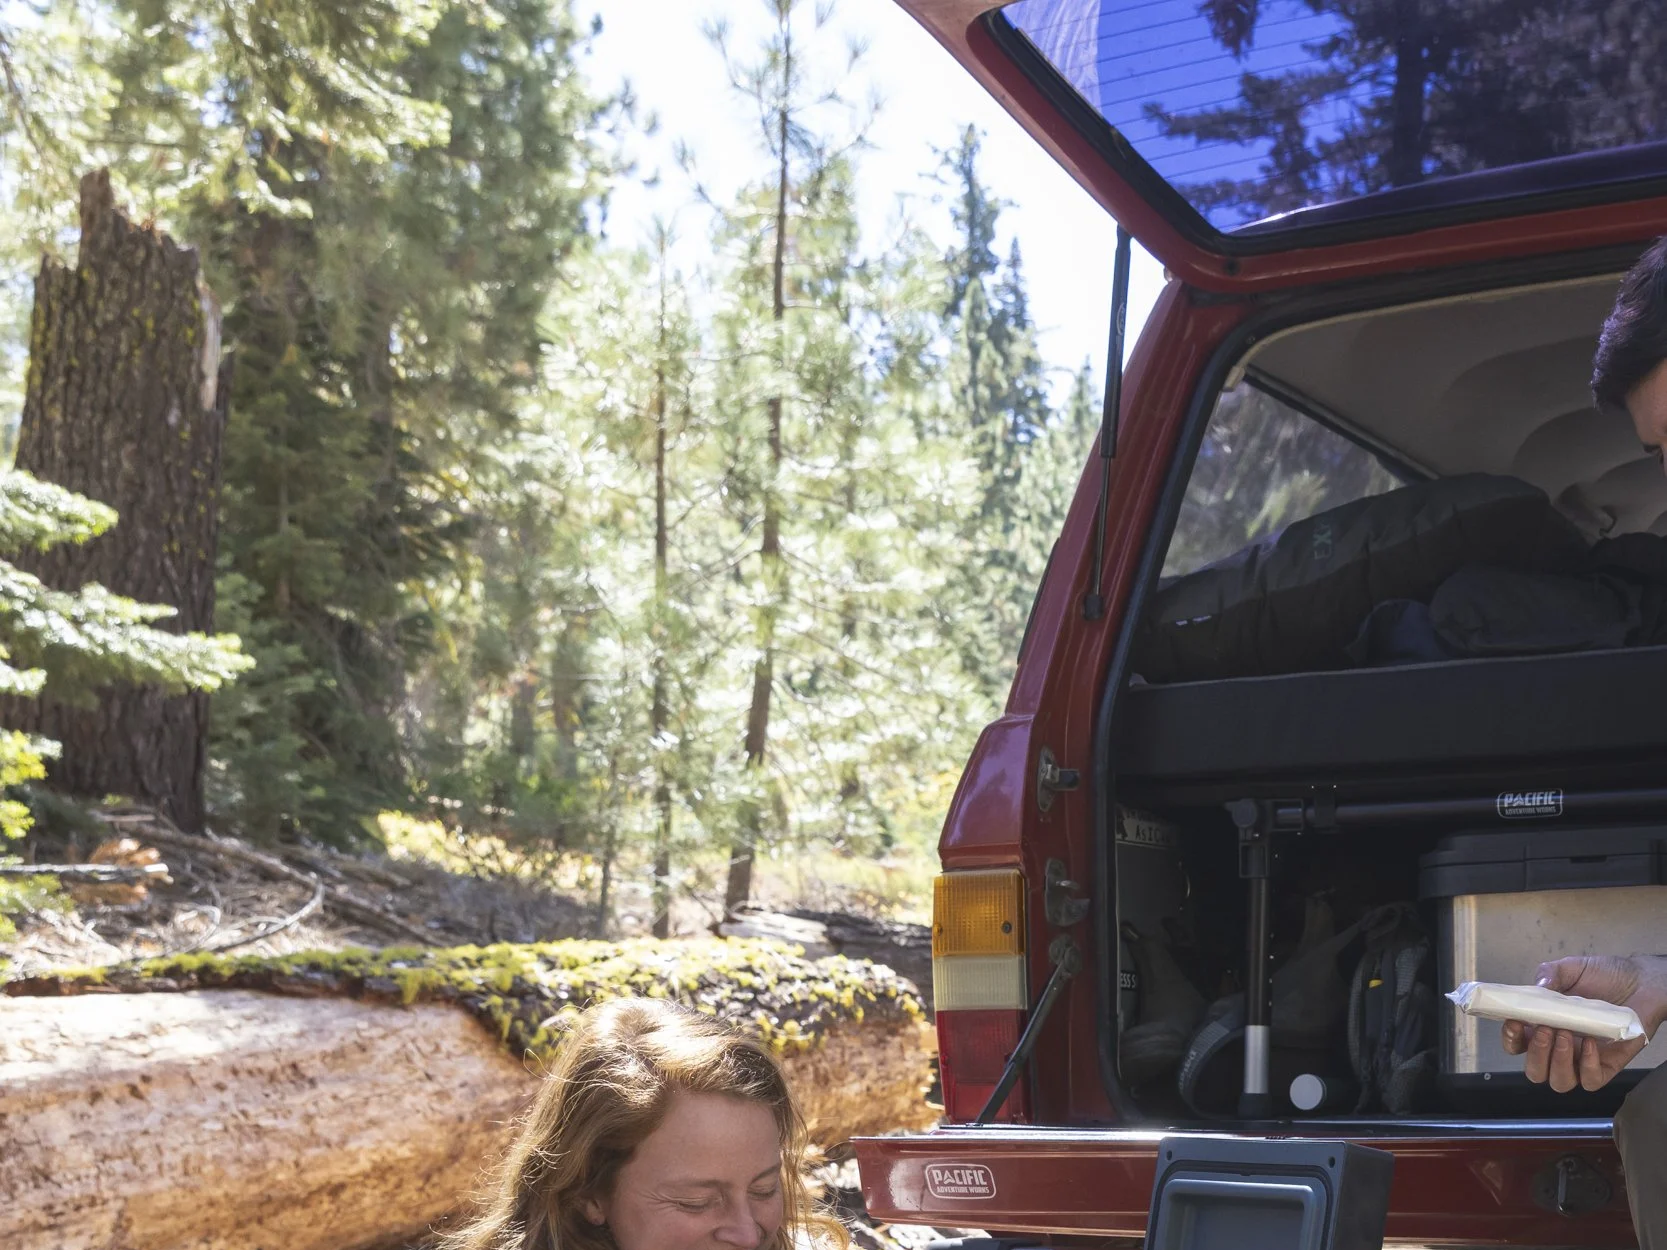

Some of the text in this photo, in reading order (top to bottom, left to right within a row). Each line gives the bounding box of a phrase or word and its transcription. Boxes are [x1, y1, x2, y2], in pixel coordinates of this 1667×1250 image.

[1504, 791, 1556, 807] PACIFIC
[932, 1169, 987, 1185] PACIFIC
[936, 1186, 990, 1194] ADVENTURE WORKS
